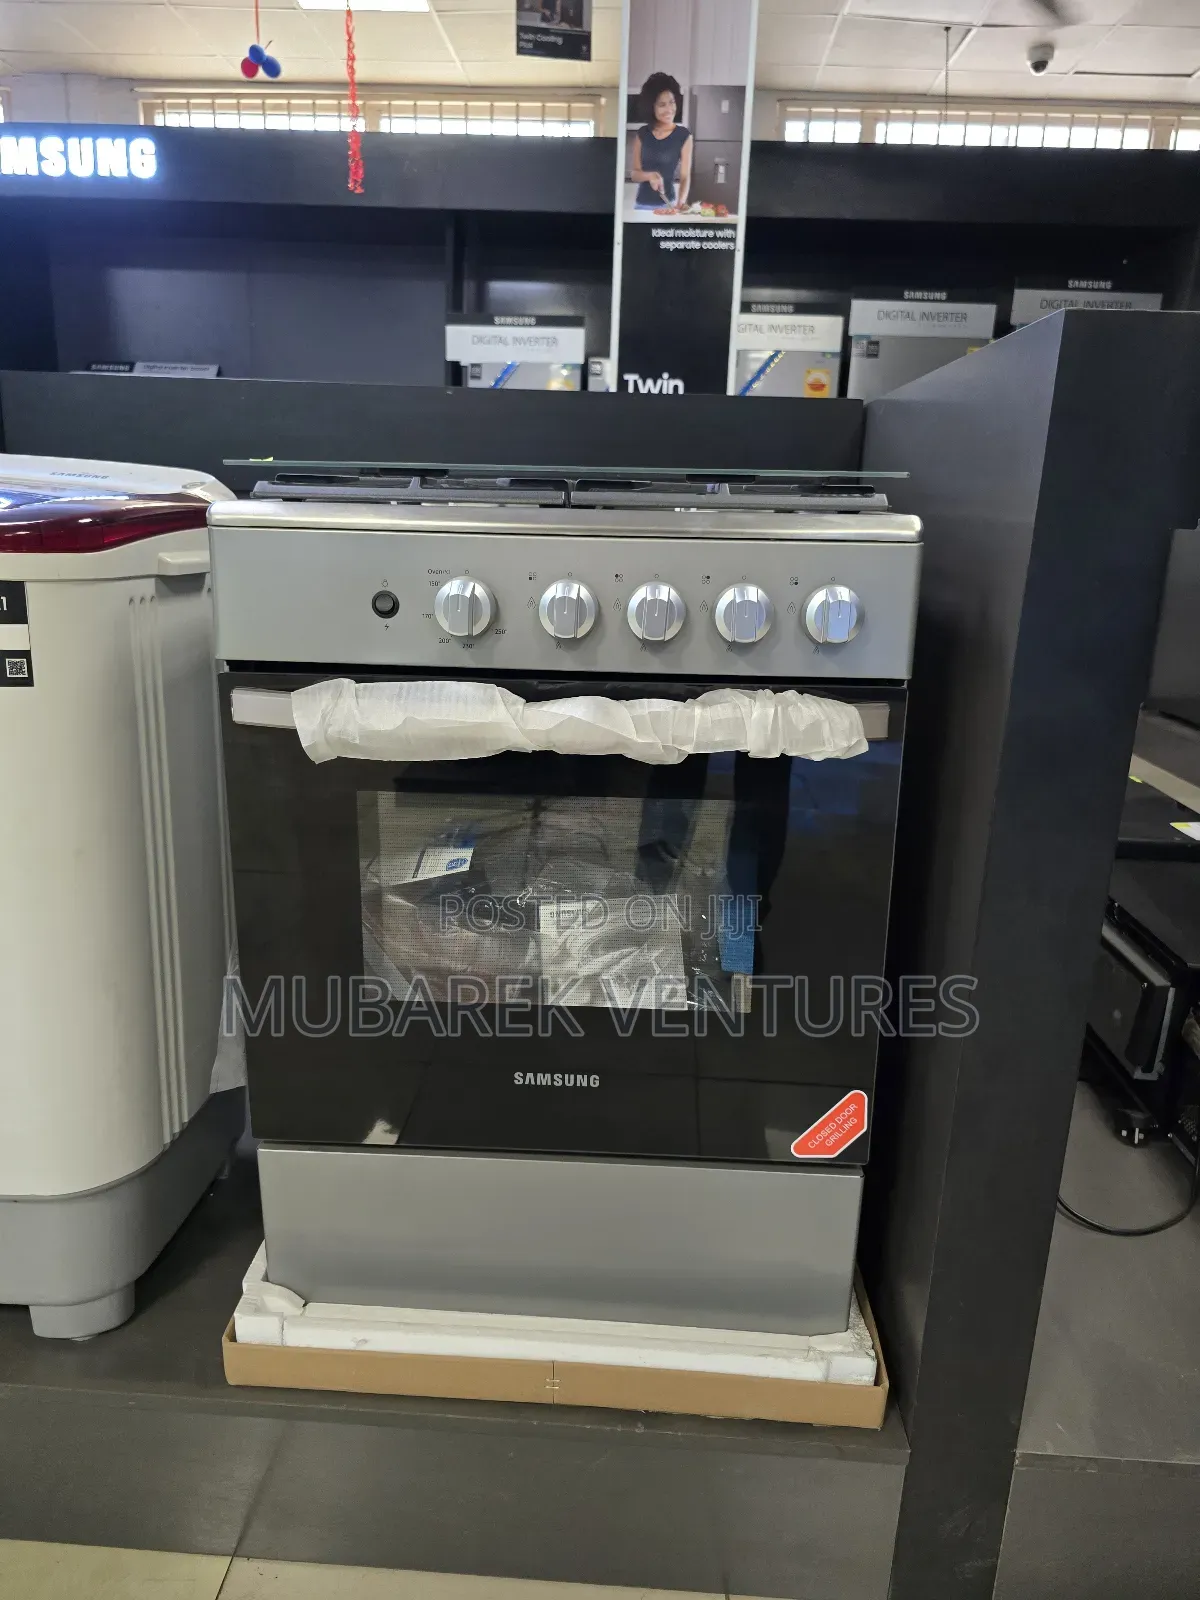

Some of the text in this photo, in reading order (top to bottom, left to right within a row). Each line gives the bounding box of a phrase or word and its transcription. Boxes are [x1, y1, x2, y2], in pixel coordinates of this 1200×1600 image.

[652, 227, 735, 239] Ideal moisture with
[660, 241, 734, 251] separate coolers
[1067, 280, 1112, 289] SAMSUNG
[904, 290, 947, 300] SAMSUNG
[751, 303, 795, 313] SAMSUNG
[494, 316, 537, 326] SAMSUNG
[877, 309, 967, 323] DIGITAL INVERTER
[768, 324, 815, 336] INVERTER
[472, 335, 559, 348] DIGITAL INVERTER
[623, 372, 684, 395] Twin
[50, 471, 109, 480] SAMSUNG
[513, 1071, 600, 1088] SAMSUNG
[808, 1103, 858, 1149] CLOSED DOOR
[824, 1116, 858, 1147] GRILLING
